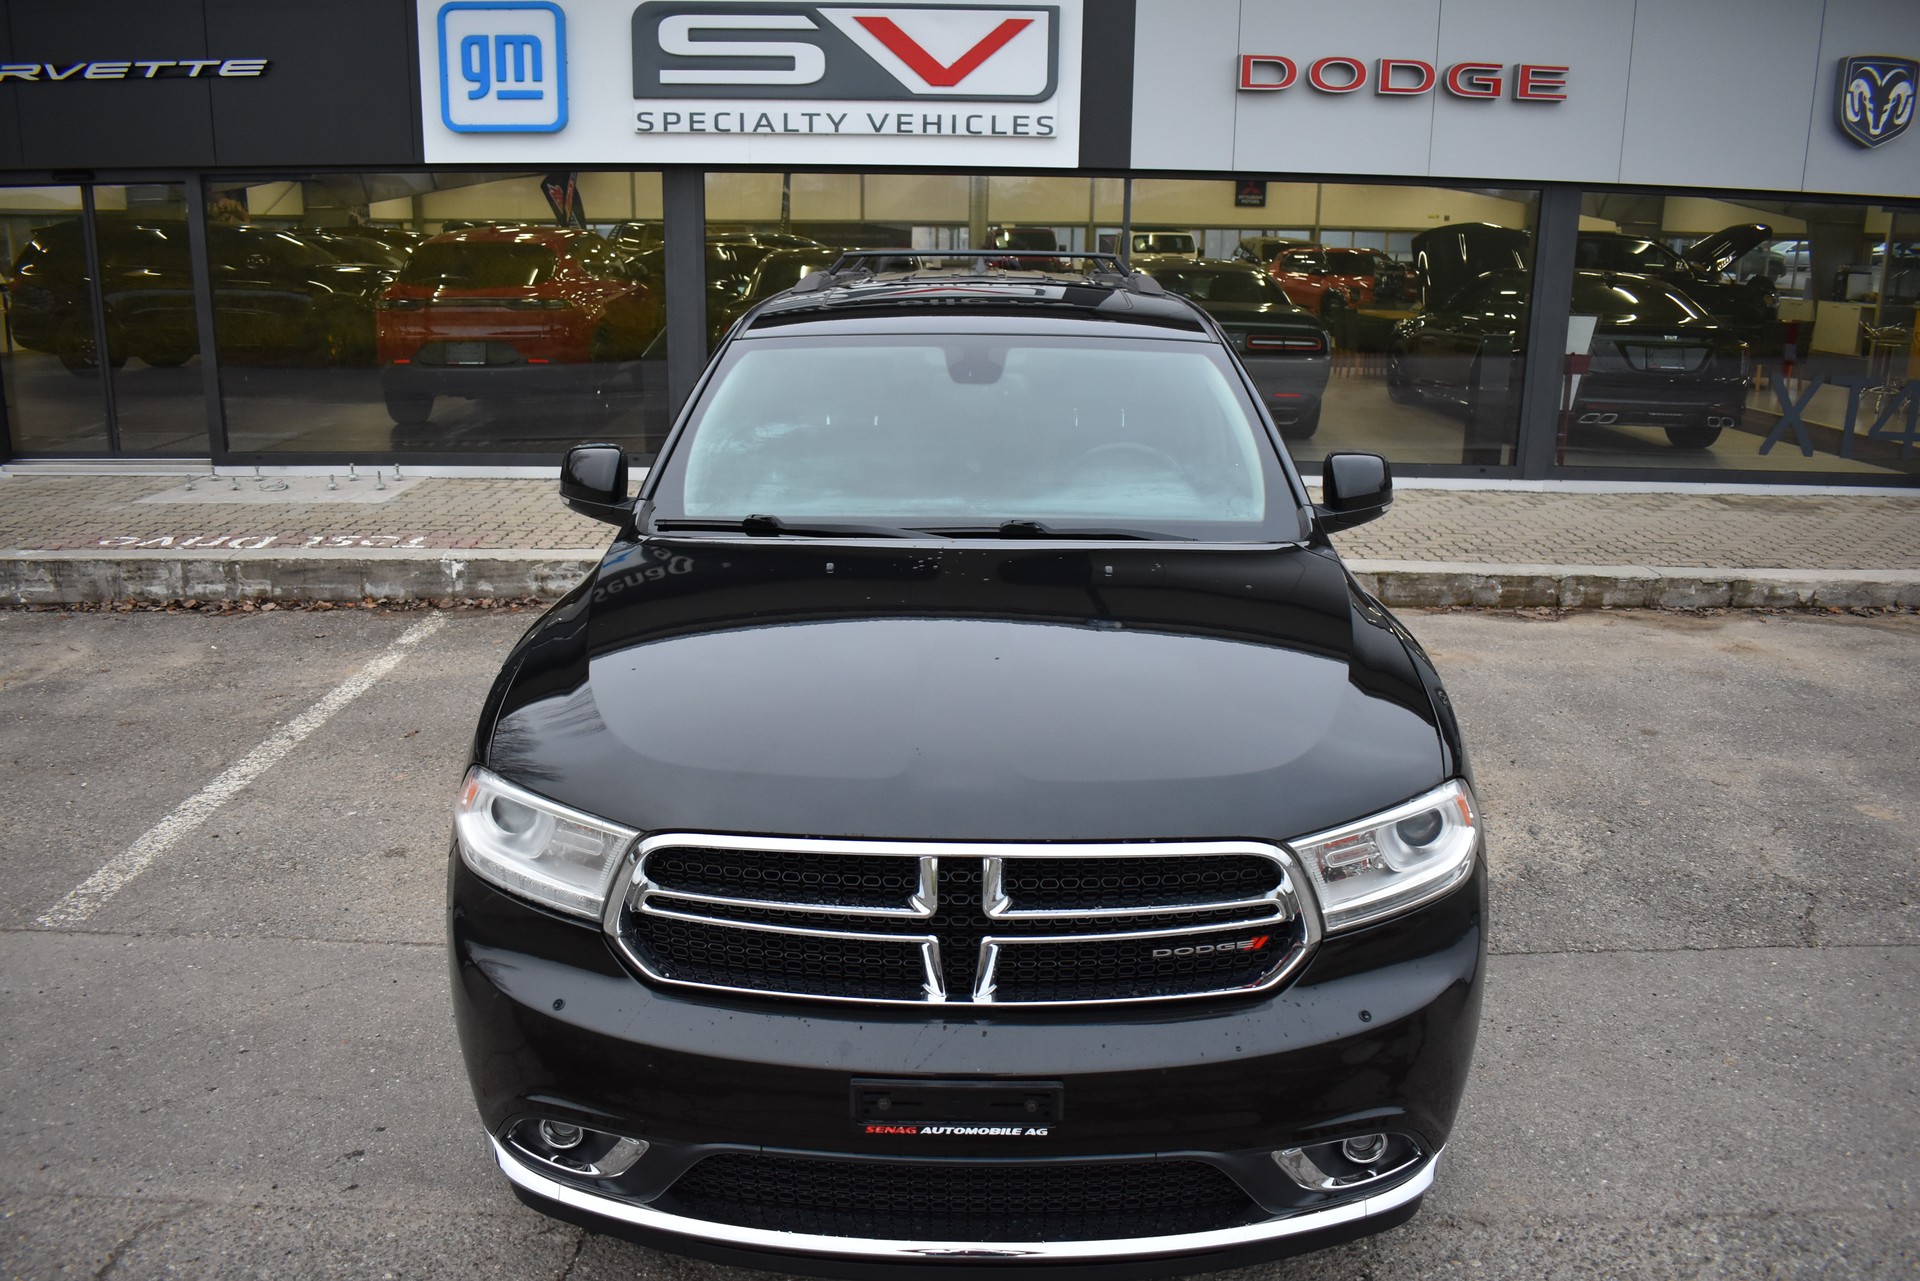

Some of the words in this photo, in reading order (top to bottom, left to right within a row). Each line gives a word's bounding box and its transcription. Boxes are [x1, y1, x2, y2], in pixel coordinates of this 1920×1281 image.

[461, 35, 543, 100] gm
[658, 14, 1036, 87] SV
[0, 59, 268, 82] RVETTE
[1237, 53, 1570, 101] DODGE
[635, 111, 848, 134] SPECIALTY
[866, 113, 1055, 136] VEHICLES
[1758, 372, 1920, 461] XT4
[1152, 940, 1255, 957] DODGE
[865, 1126, 917, 1135] SENAG
[920, 1126, 1022, 1136] AUTOMOBILE
[1024, 1128, 1049, 1136] AG
